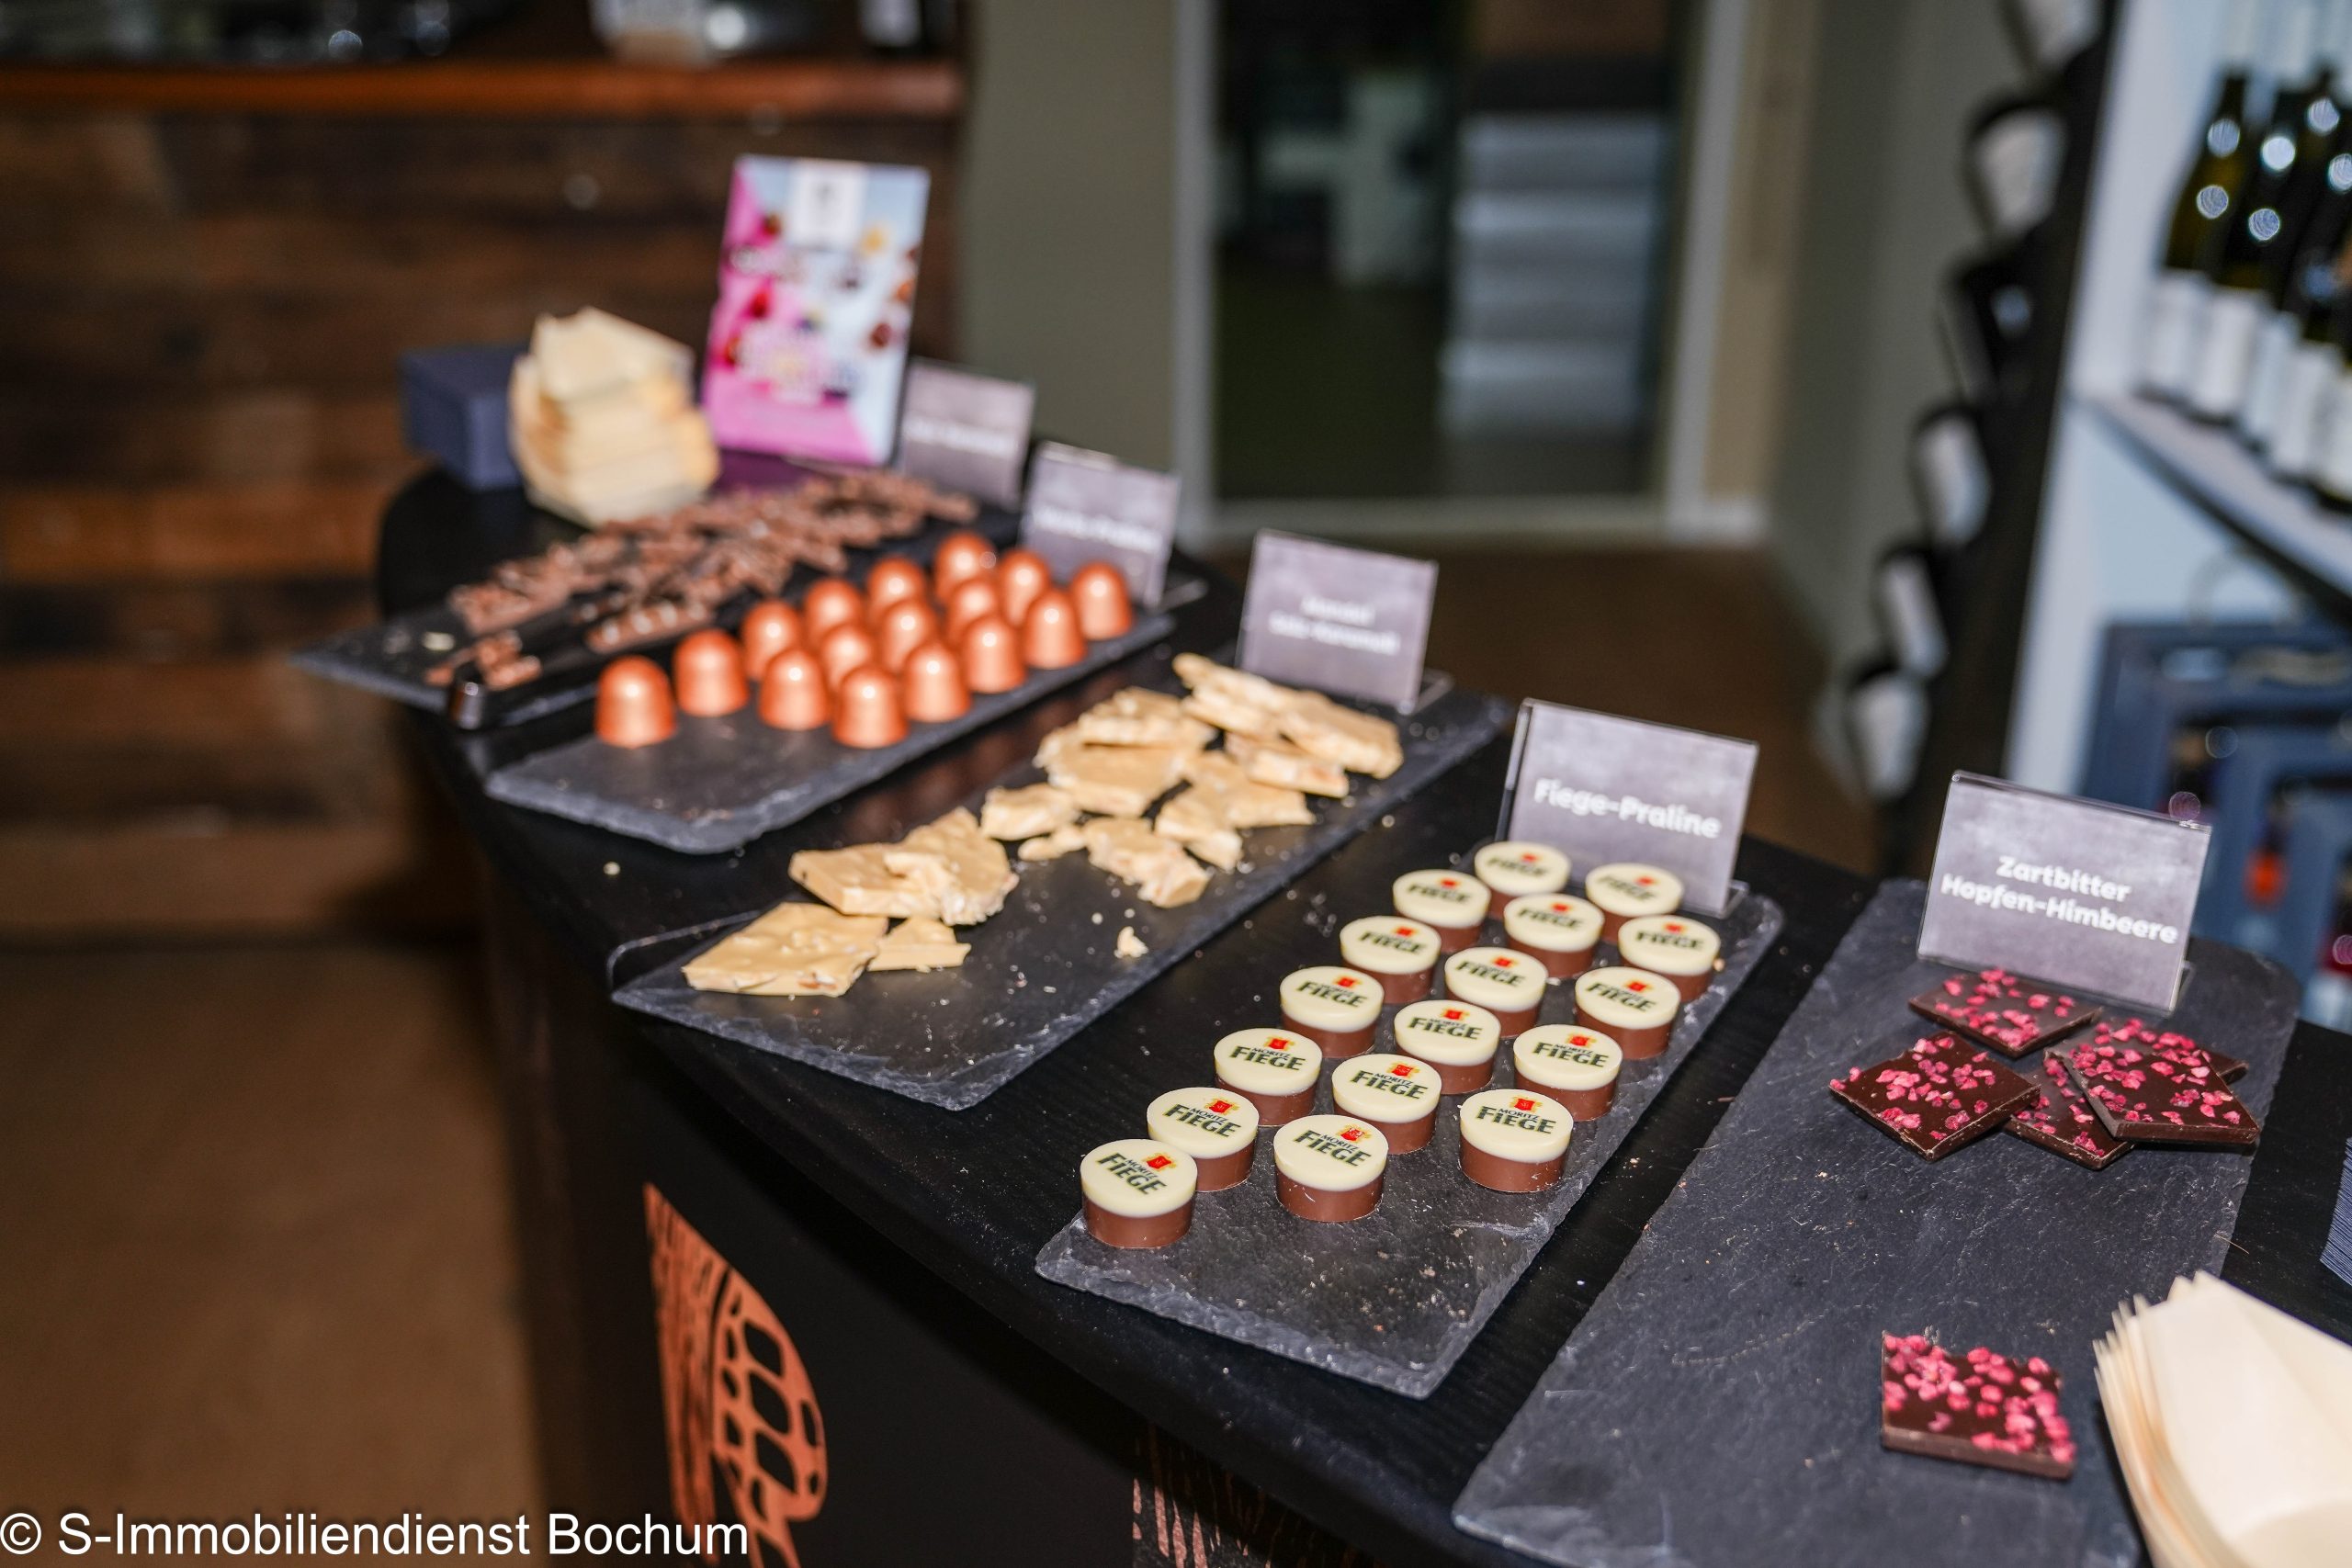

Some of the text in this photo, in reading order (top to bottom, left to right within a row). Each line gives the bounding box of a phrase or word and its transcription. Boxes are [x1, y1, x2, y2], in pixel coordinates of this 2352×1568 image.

[1533, 778, 1722, 839] Fiege-Praline
[1996, 855, 2132, 902] Zartbitter
[1940, 873, 2179, 944] Hopfen-Himbeere
[1296, 981, 1367, 1008] FIEGE
[1408, 1018, 1483, 1040] FIEGE
[1230, 1045, 1306, 1070] FIEGE
[1251, 1047, 1290, 1058] MORITZ
[1533, 1042, 1609, 1067] FIEGE
[1555, 1043, 1592, 1054] MORITZ
[1351, 1070, 1428, 1099] FIEGE
[1374, 1073, 1413, 1086] MORITZ
[1164, 1104, 1241, 1137] FIEGE
[1190, 1108, 1228, 1124] MORITZ
[1477, 1106, 1556, 1134] FIEGE
[1498, 1109, 1540, 1120] MORITZ
[1295, 1130, 1371, 1167] FIEGE
[1320, 1134, 1358, 1151] MORITZ
[1097, 1152, 1167, 1194] FIEGE
[1125, 1159, 1159, 1179] MORITZ
